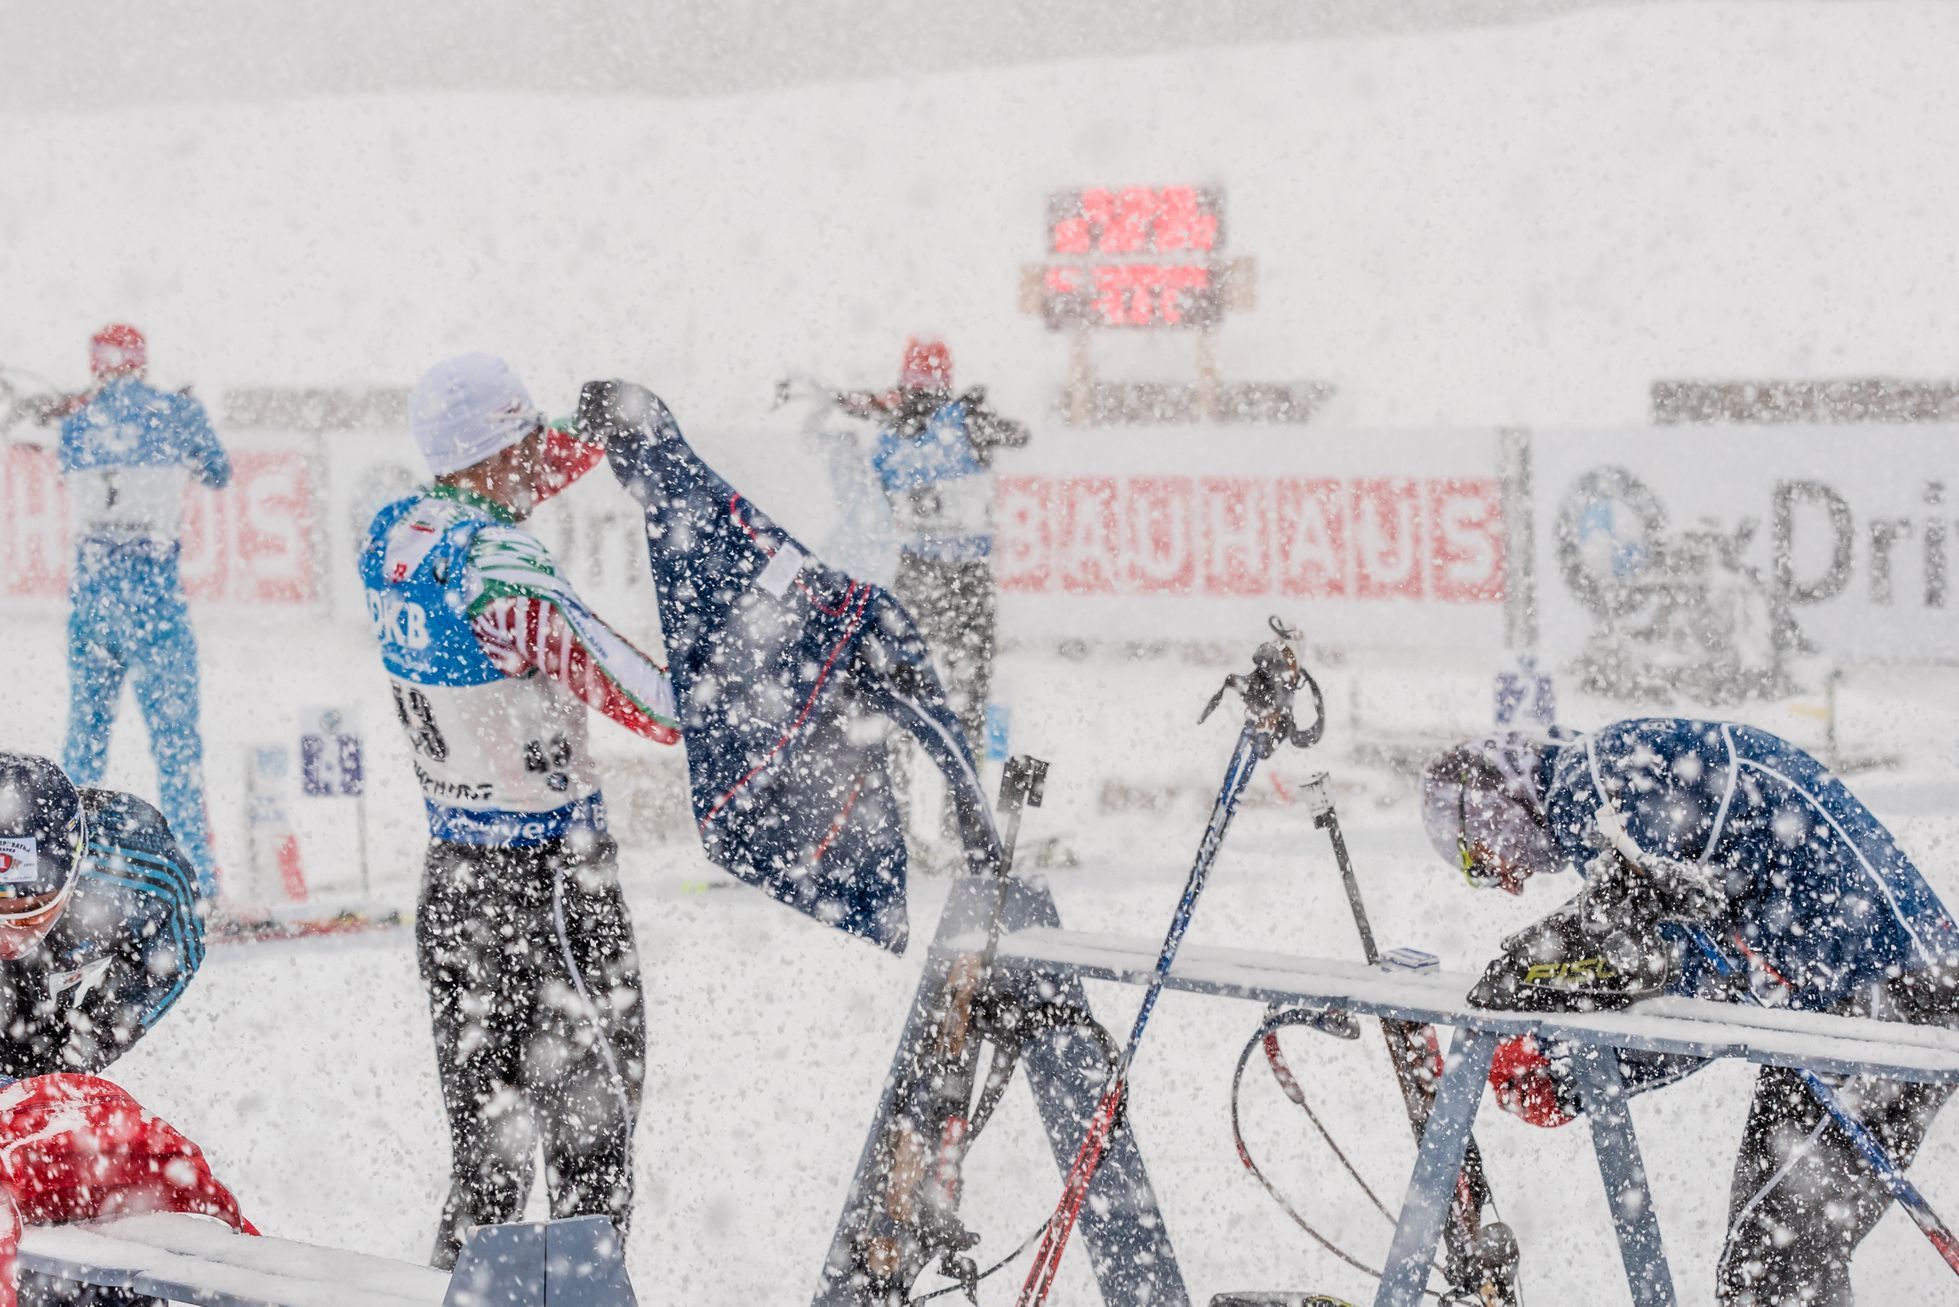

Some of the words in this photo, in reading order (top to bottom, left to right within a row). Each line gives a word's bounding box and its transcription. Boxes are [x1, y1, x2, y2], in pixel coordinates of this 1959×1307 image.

[1000, 490, 1500, 590] BAUHAUS
[1697, 477, 1959, 606] xDri
[366, 587, 430, 650] DKB
